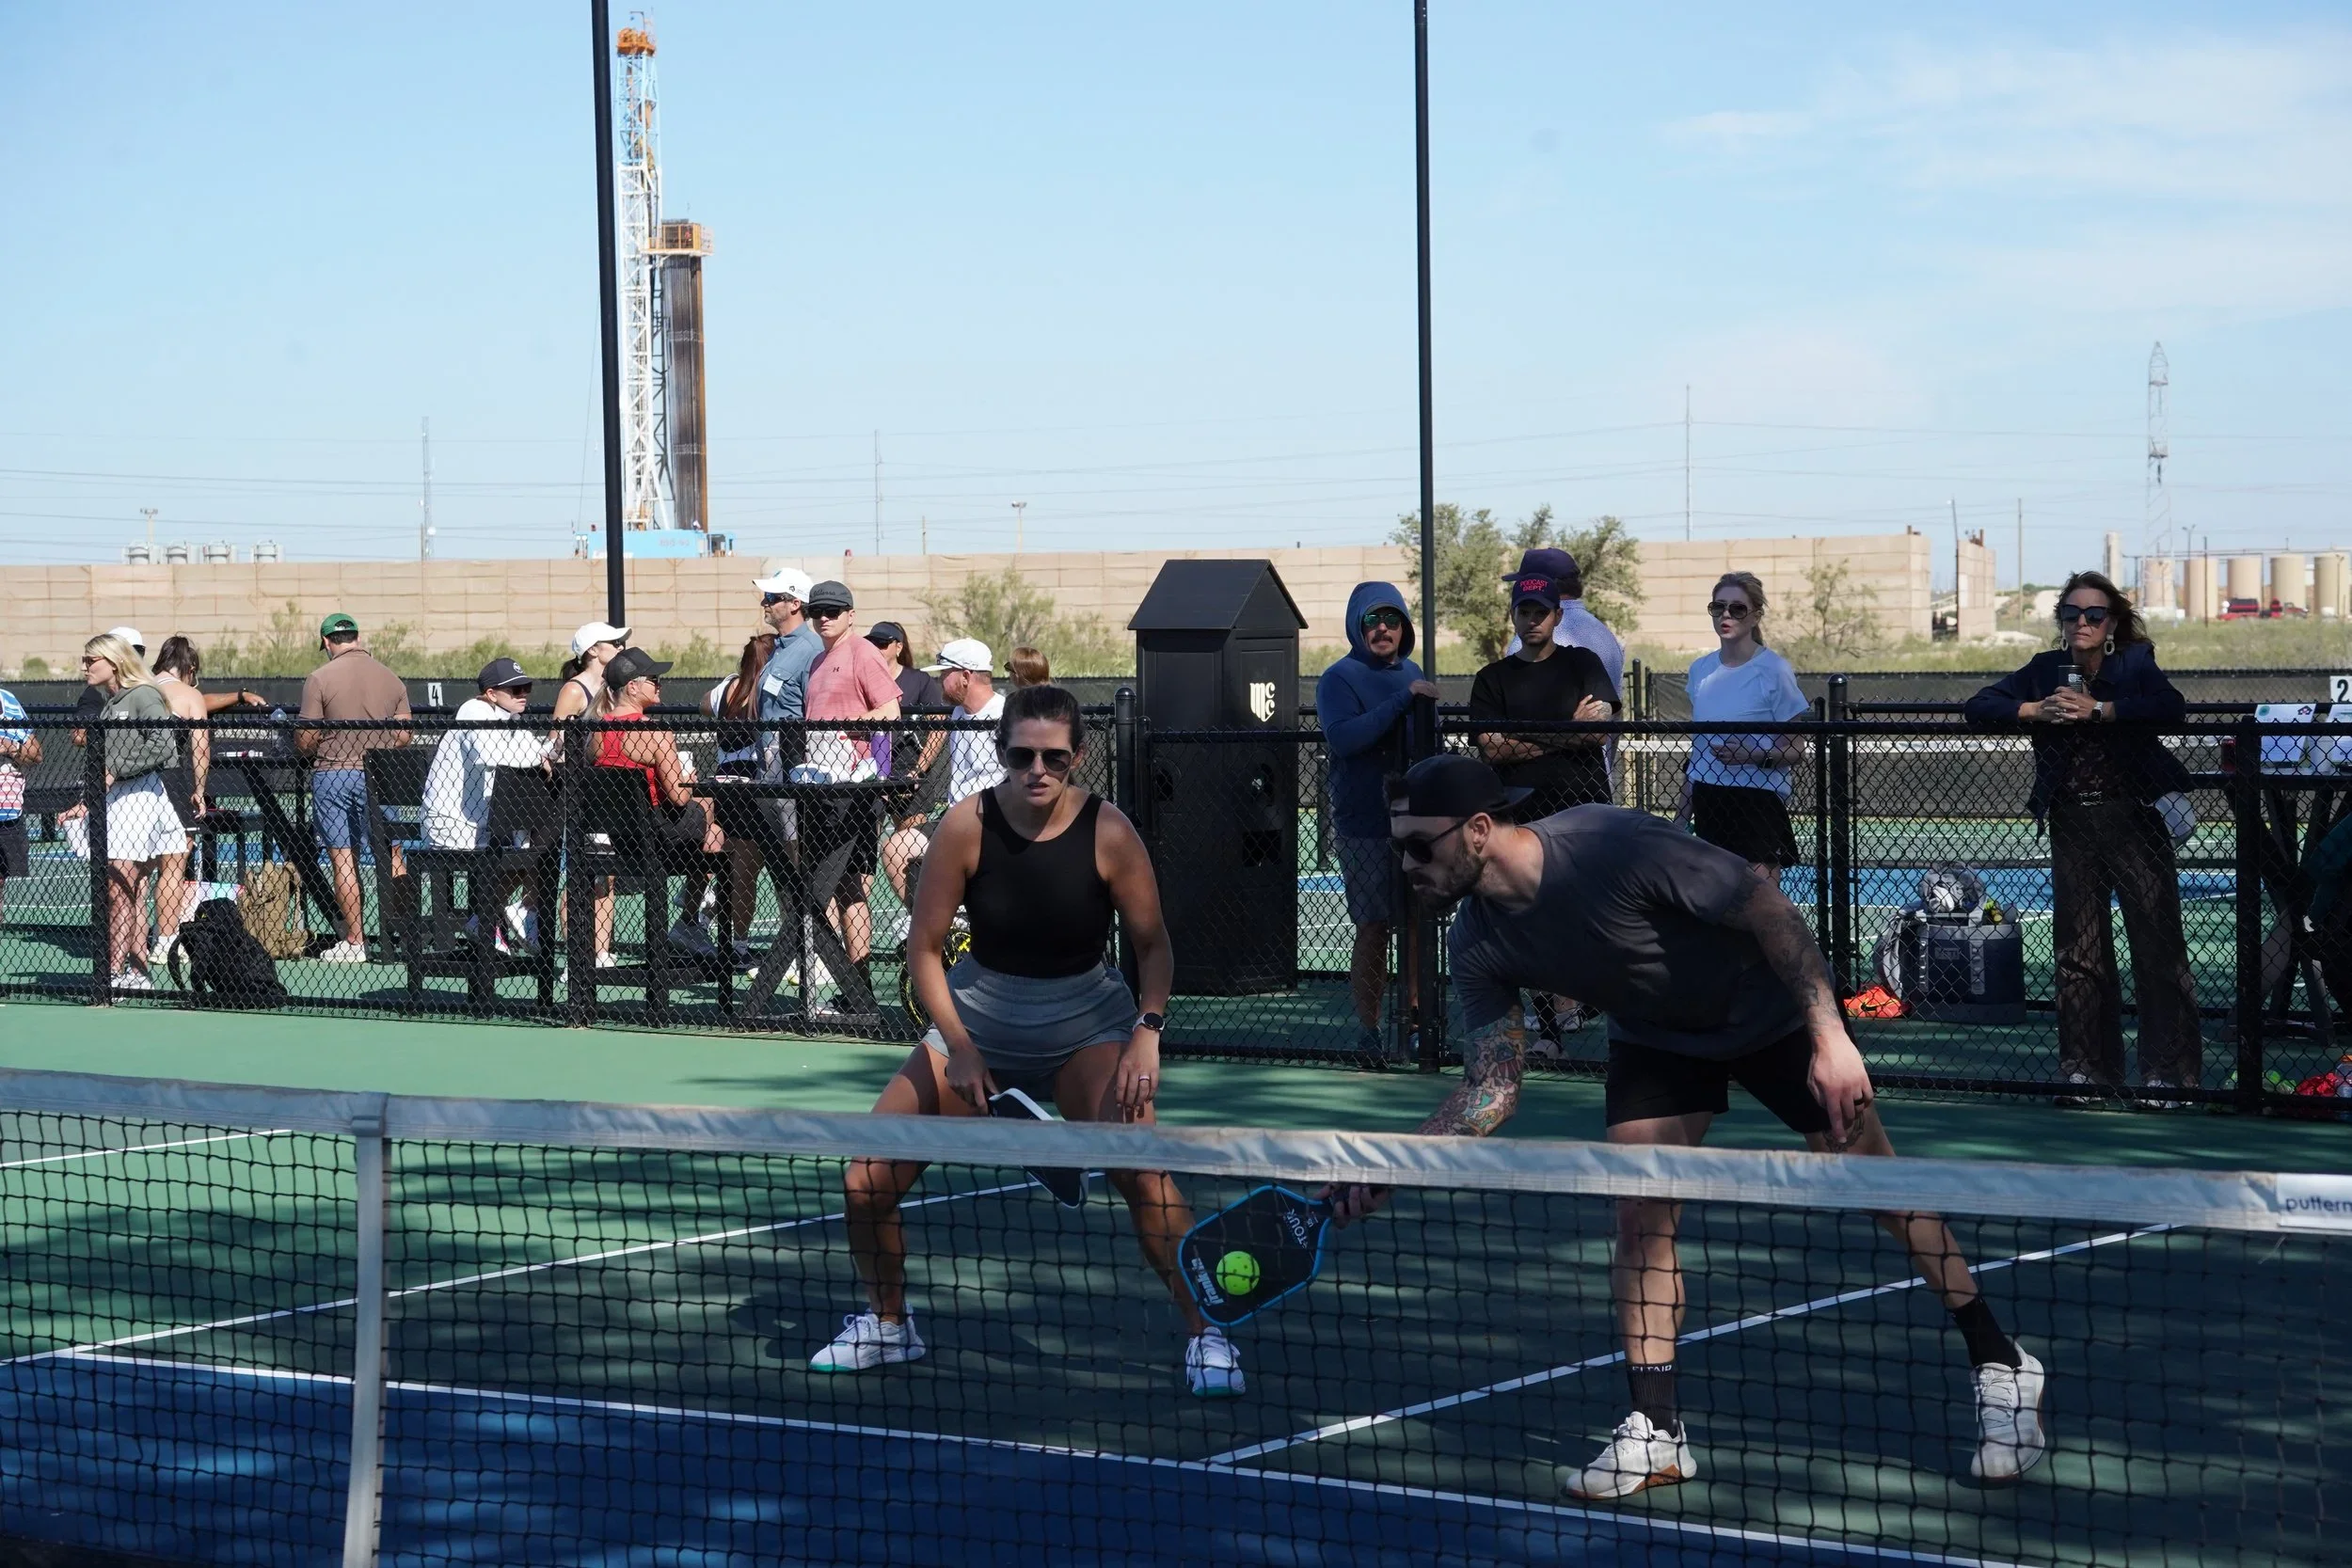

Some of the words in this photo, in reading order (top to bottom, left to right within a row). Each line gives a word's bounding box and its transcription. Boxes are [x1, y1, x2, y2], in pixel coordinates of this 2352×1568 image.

[432, 685, 439, 708] 4
[2337, 678, 2349, 704] 2
[1191, 1257, 1224, 1307] Frankin
